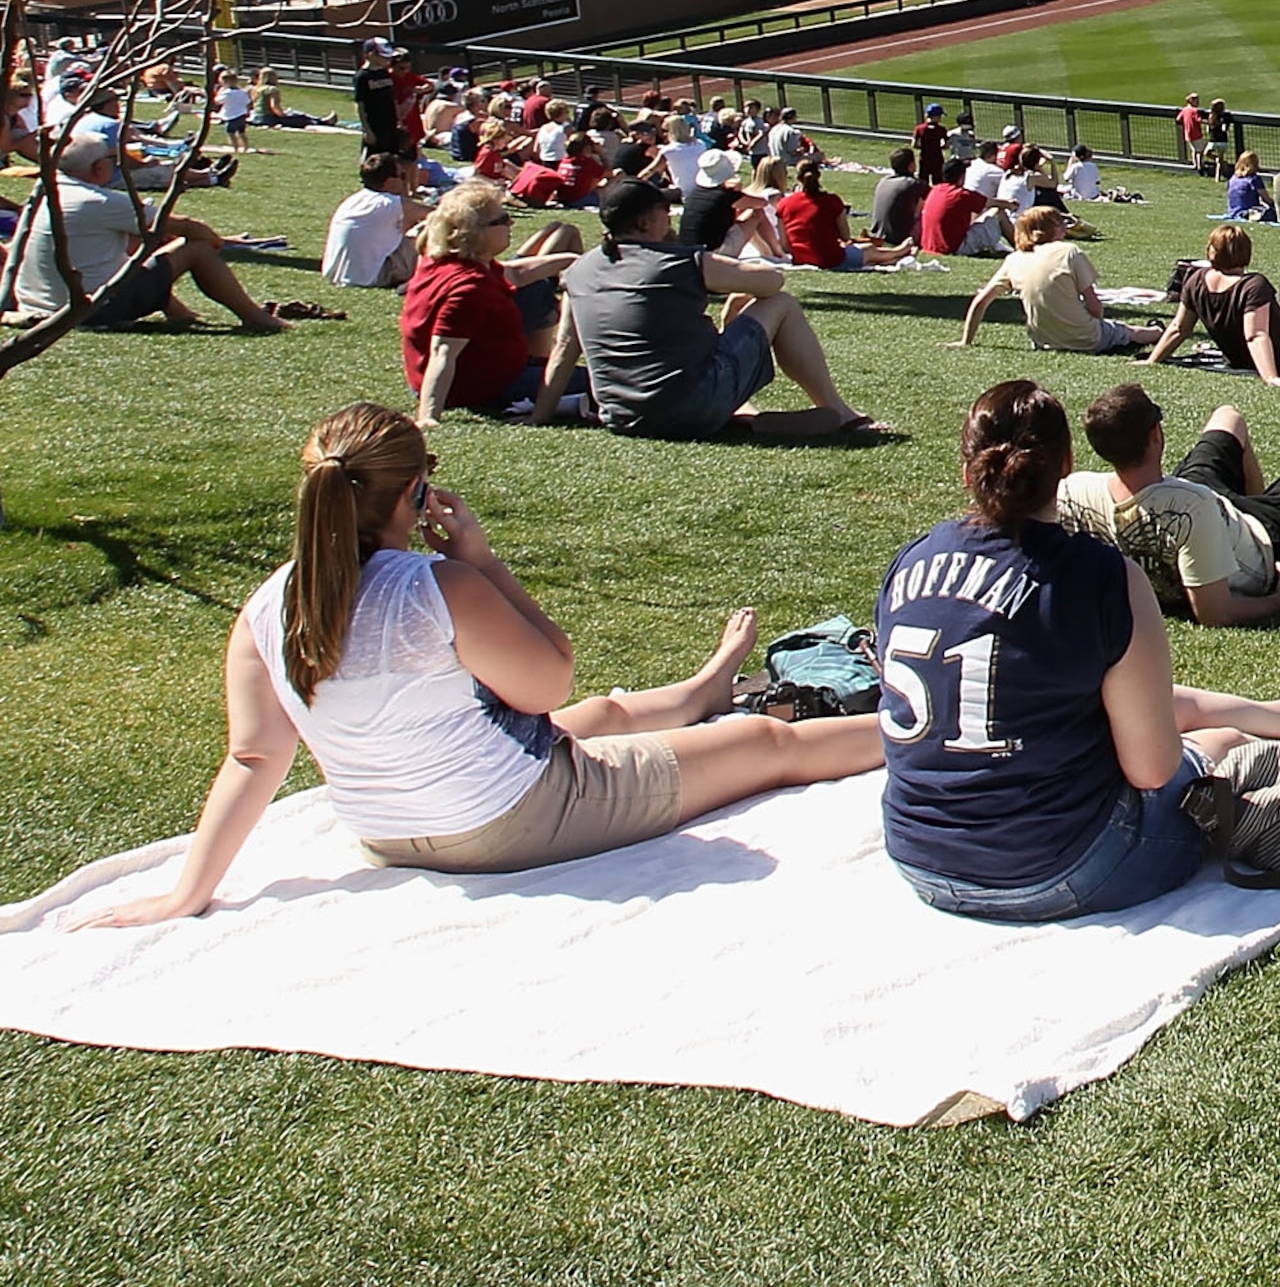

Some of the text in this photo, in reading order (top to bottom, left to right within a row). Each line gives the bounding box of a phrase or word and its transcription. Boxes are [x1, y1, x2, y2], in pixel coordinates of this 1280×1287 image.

[491, 1, 519, 15] North
[542, 6, 570, 18] Peoria
[890, 551, 1040, 620] HOFFMAN
[879, 624, 1014, 753] 51
